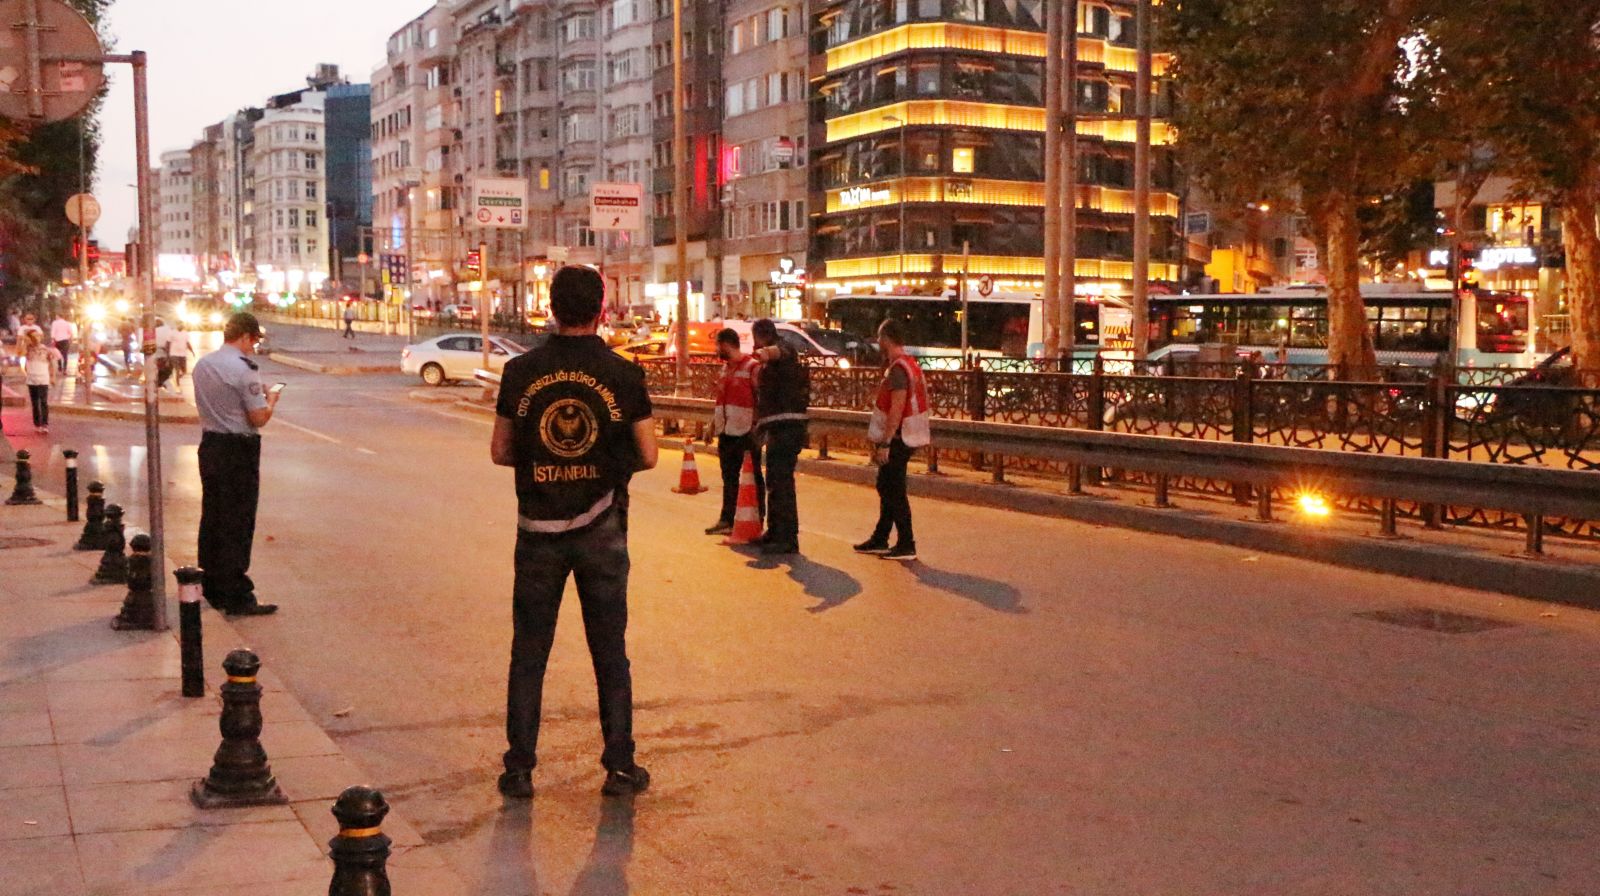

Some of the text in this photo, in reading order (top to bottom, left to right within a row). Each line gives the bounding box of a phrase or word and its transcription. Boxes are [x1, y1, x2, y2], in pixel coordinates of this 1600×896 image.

[1481, 247, 1537, 264] HOTEL
[517, 397, 530, 417] OTO
[569, 371, 596, 387] BÜRO
[533, 461, 601, 482] İSTANBUL
